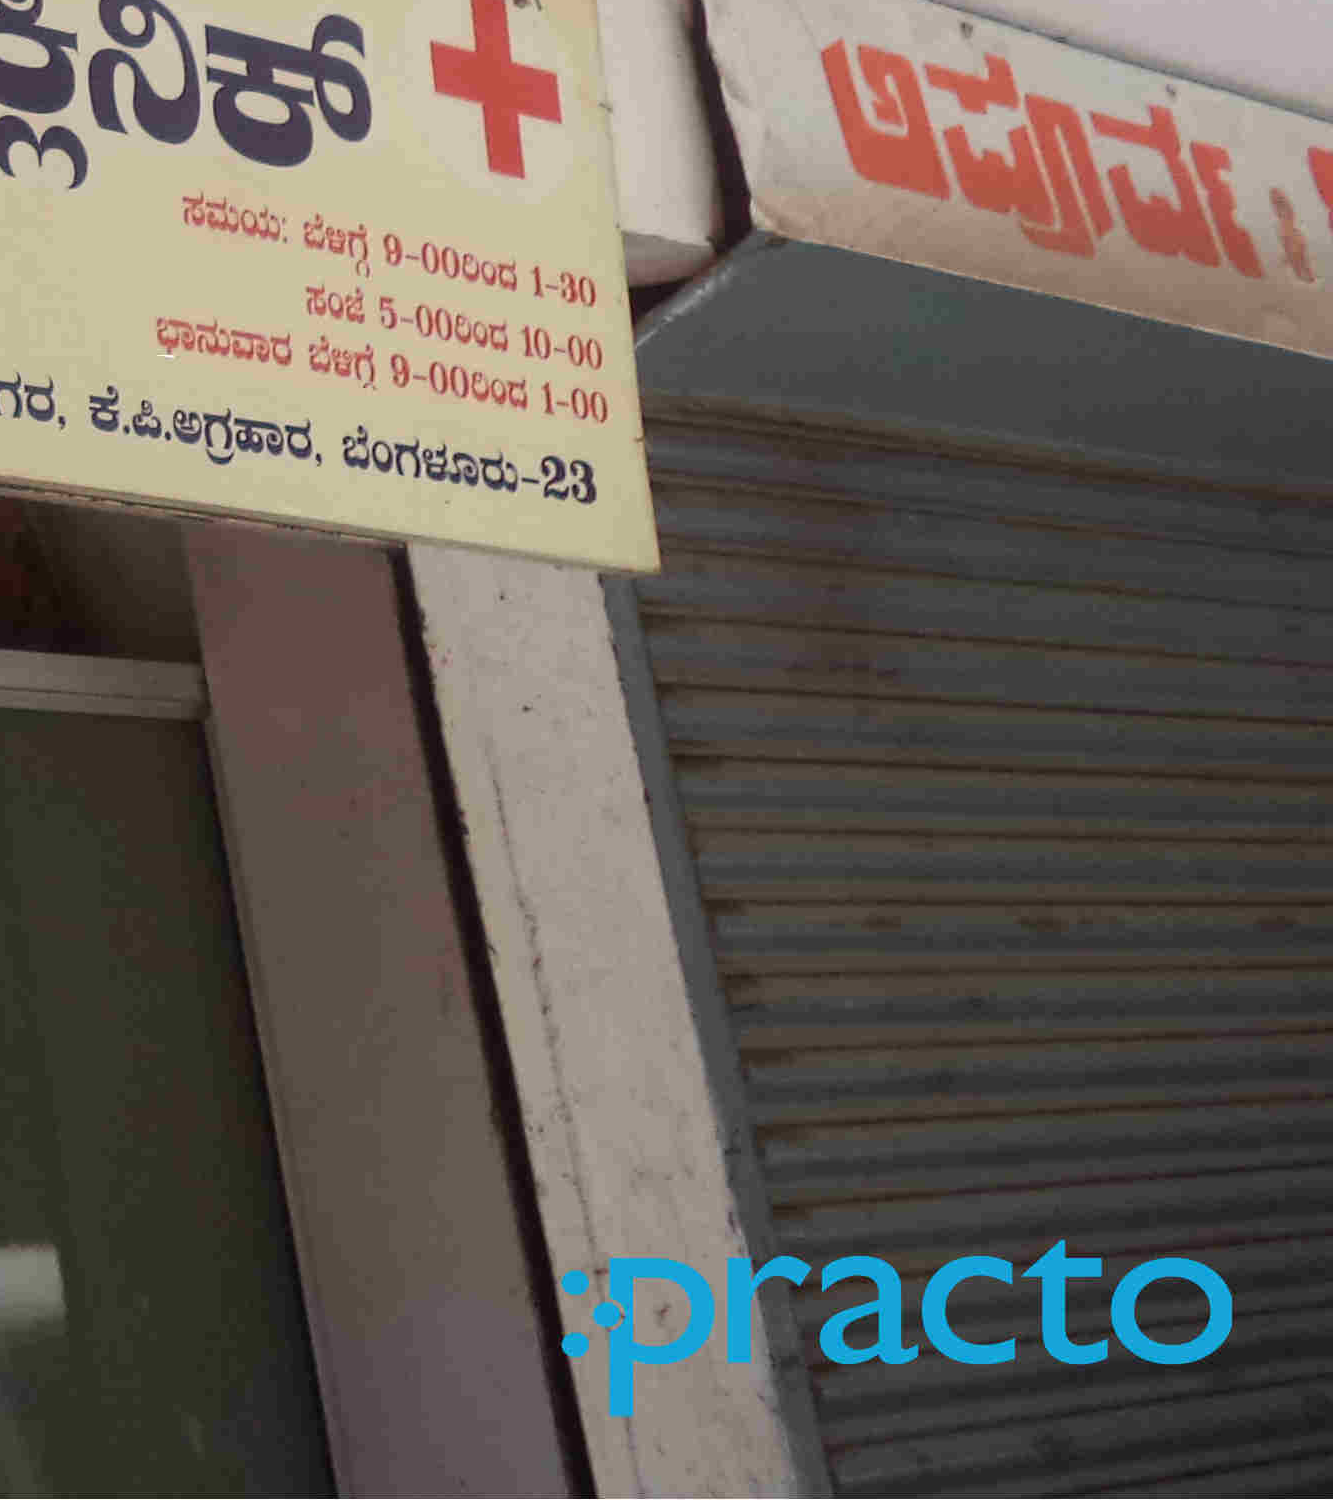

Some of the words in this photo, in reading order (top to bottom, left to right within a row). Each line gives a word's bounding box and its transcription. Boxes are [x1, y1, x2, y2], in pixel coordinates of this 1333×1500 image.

[305, 283, 367, 324] ಸಂಜೆ
[522, 323, 604, 371] 10-00
[531, 264, 598, 308] 1-30
[156, 315, 294, 368] ಭಾನುವಾರ
[540, 380, 610, 425] 1-00
